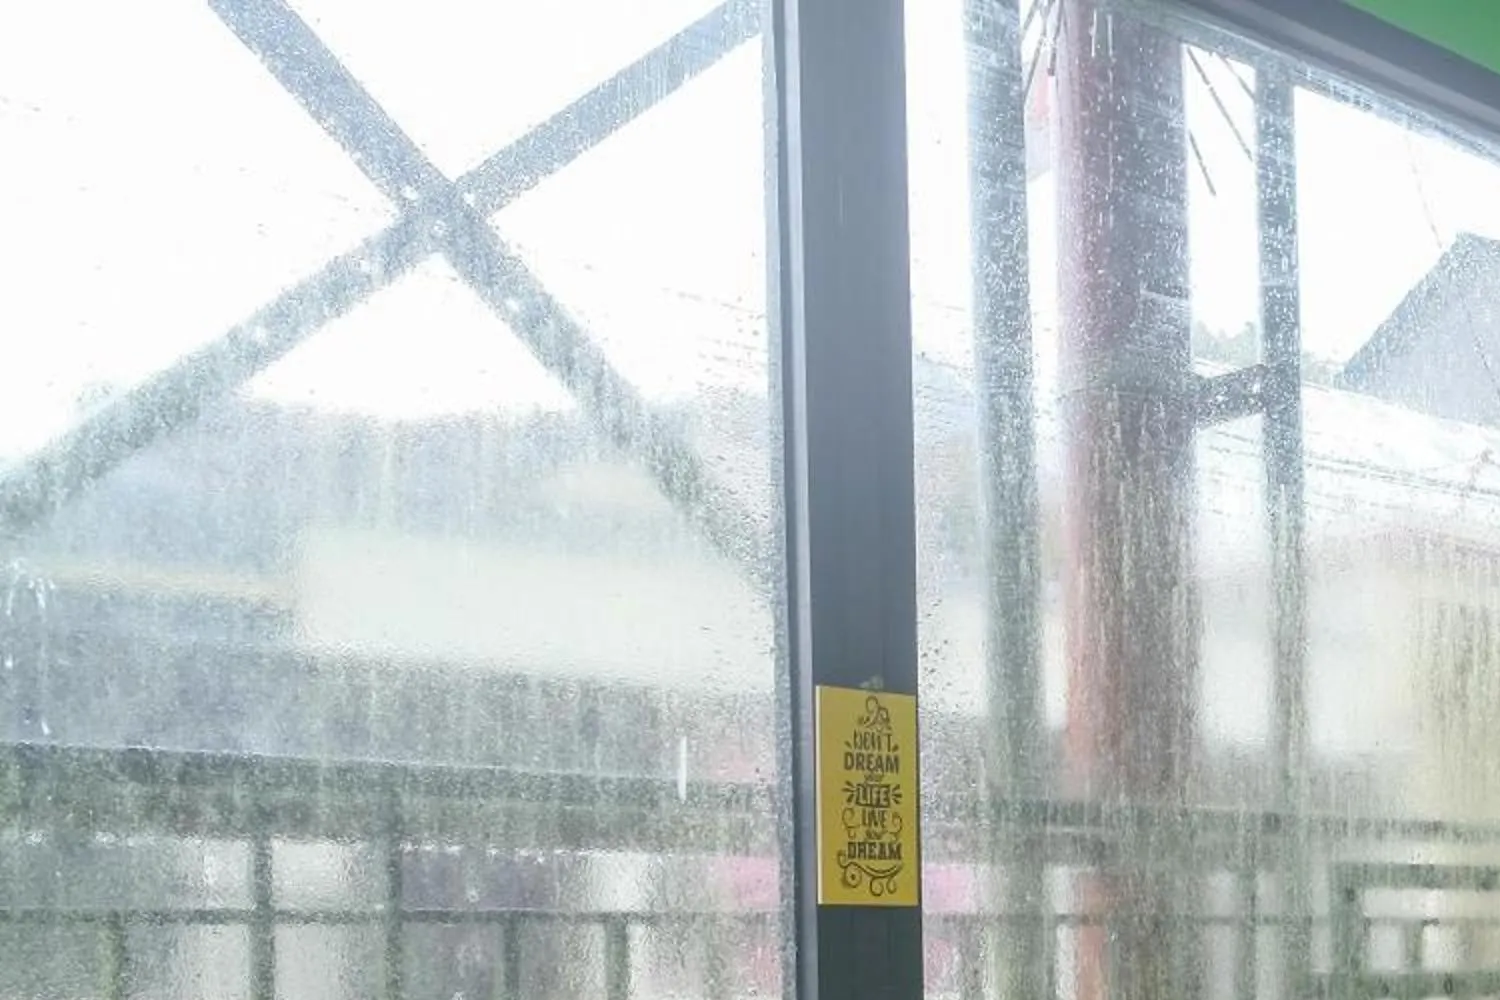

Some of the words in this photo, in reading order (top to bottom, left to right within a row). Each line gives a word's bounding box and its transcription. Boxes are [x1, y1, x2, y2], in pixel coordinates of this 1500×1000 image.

[844, 752, 899, 774] DREAM
[858, 785, 889, 806] LIFE
[861, 808, 886, 829] LIVE
[847, 842, 902, 860] DREAM
